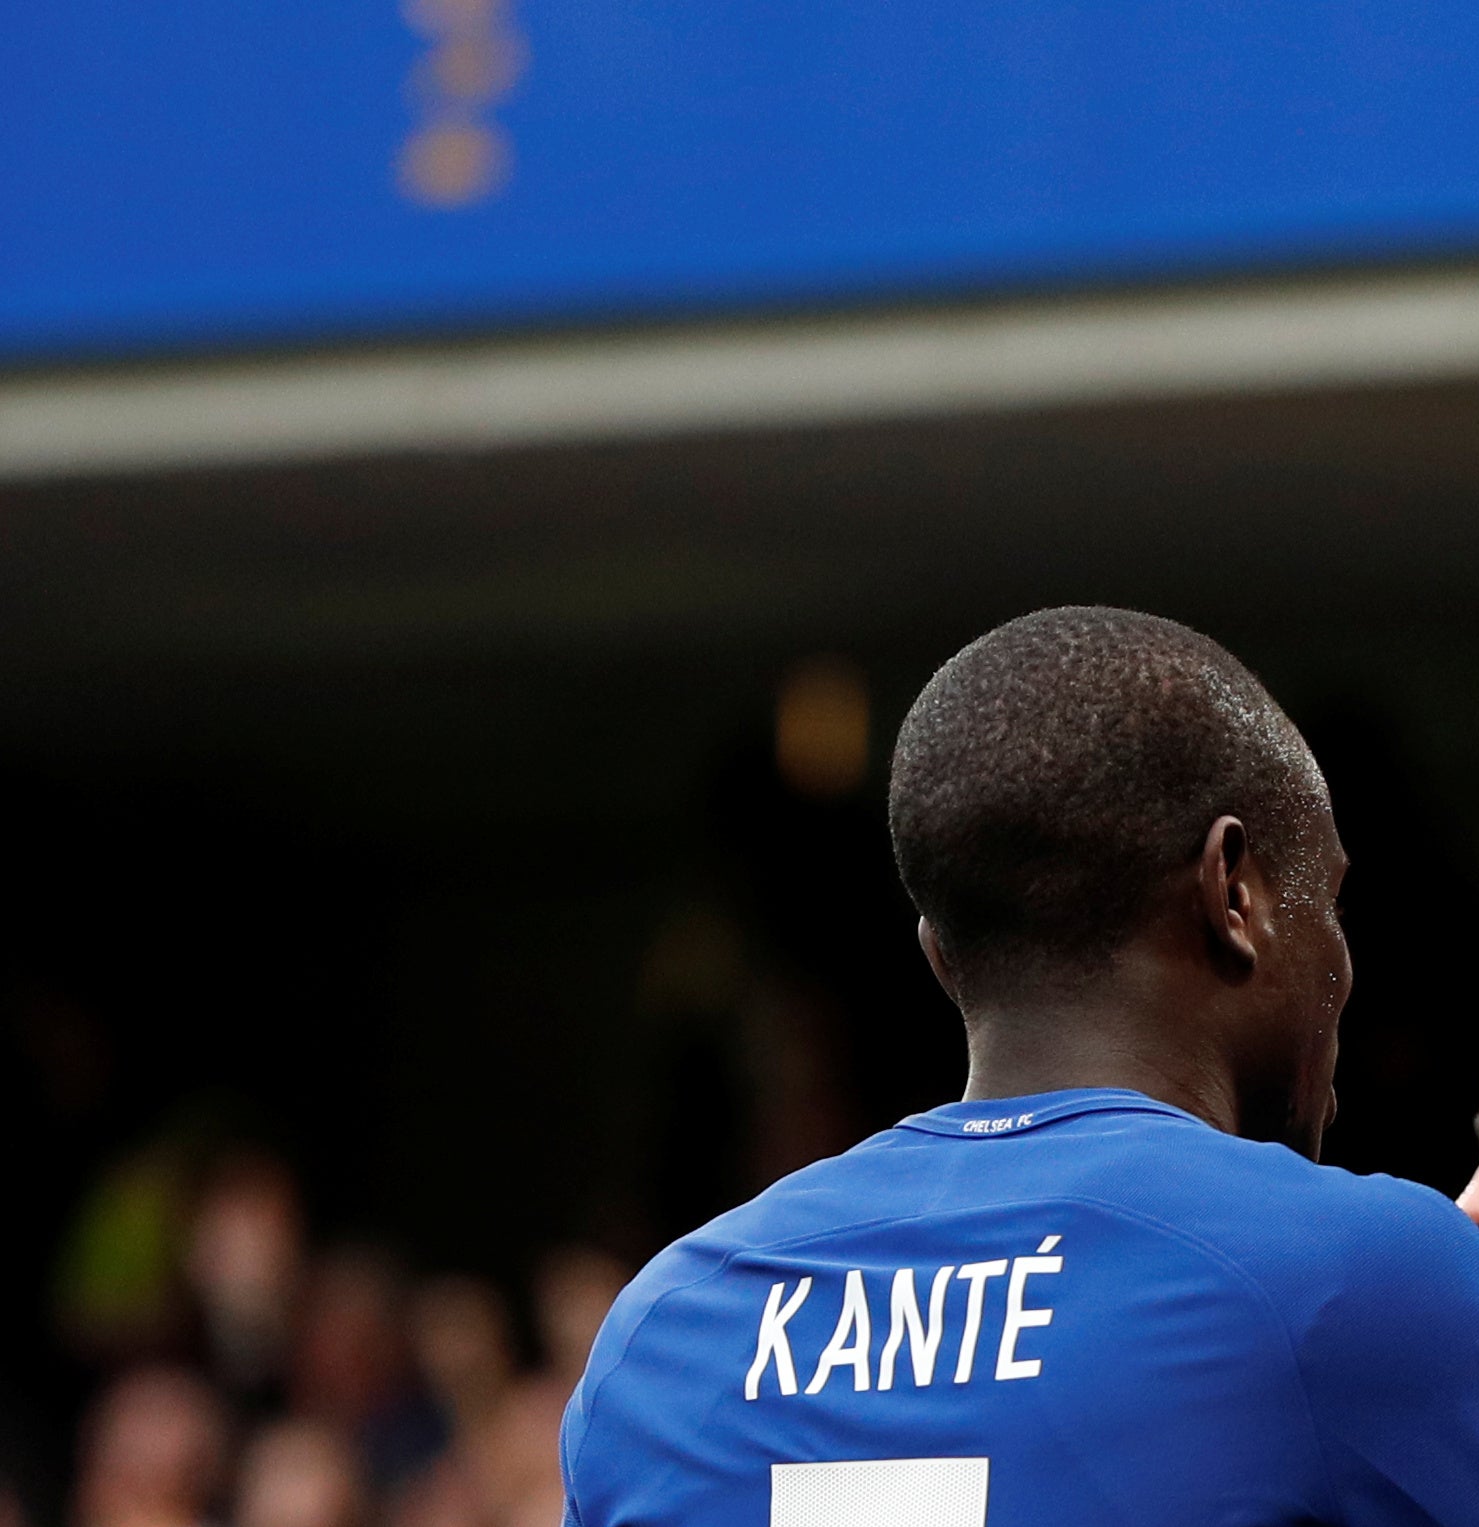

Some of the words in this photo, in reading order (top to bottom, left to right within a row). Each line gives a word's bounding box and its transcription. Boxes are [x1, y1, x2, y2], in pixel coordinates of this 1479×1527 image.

[963, 1118, 1012, 1133] CHELSEA
[1017, 1113, 1034, 1127] FC
[745, 1235, 1063, 1400] KANTÉ
